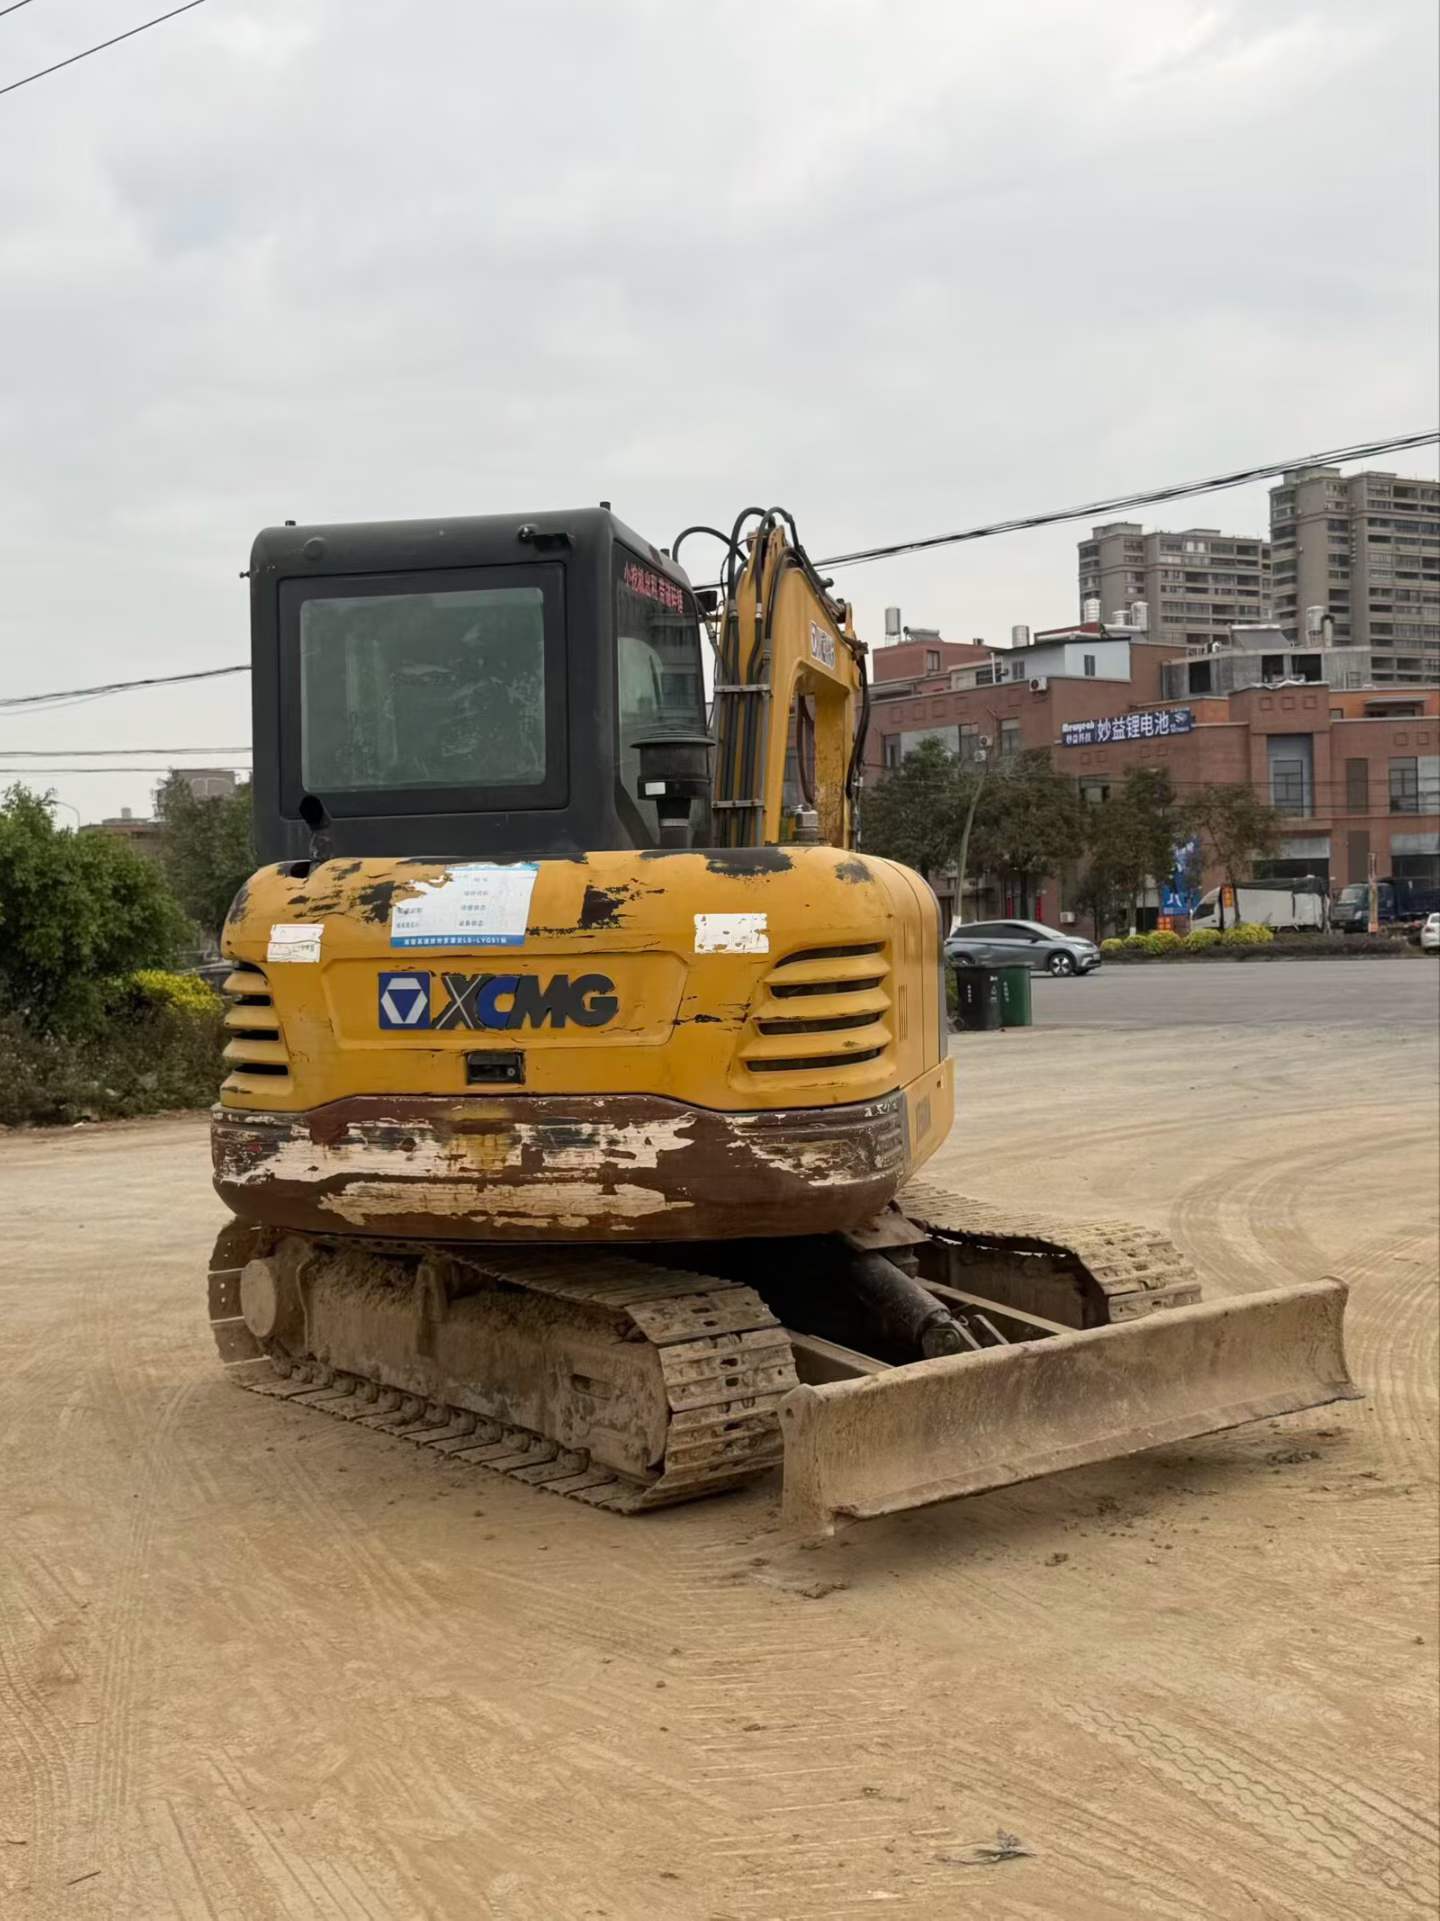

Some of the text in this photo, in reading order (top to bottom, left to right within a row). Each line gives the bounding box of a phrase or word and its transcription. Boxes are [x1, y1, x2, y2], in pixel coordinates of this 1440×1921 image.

[1097, 711, 1170, 742] 妙益锂电池
[432, 972, 618, 1030] XCMG
